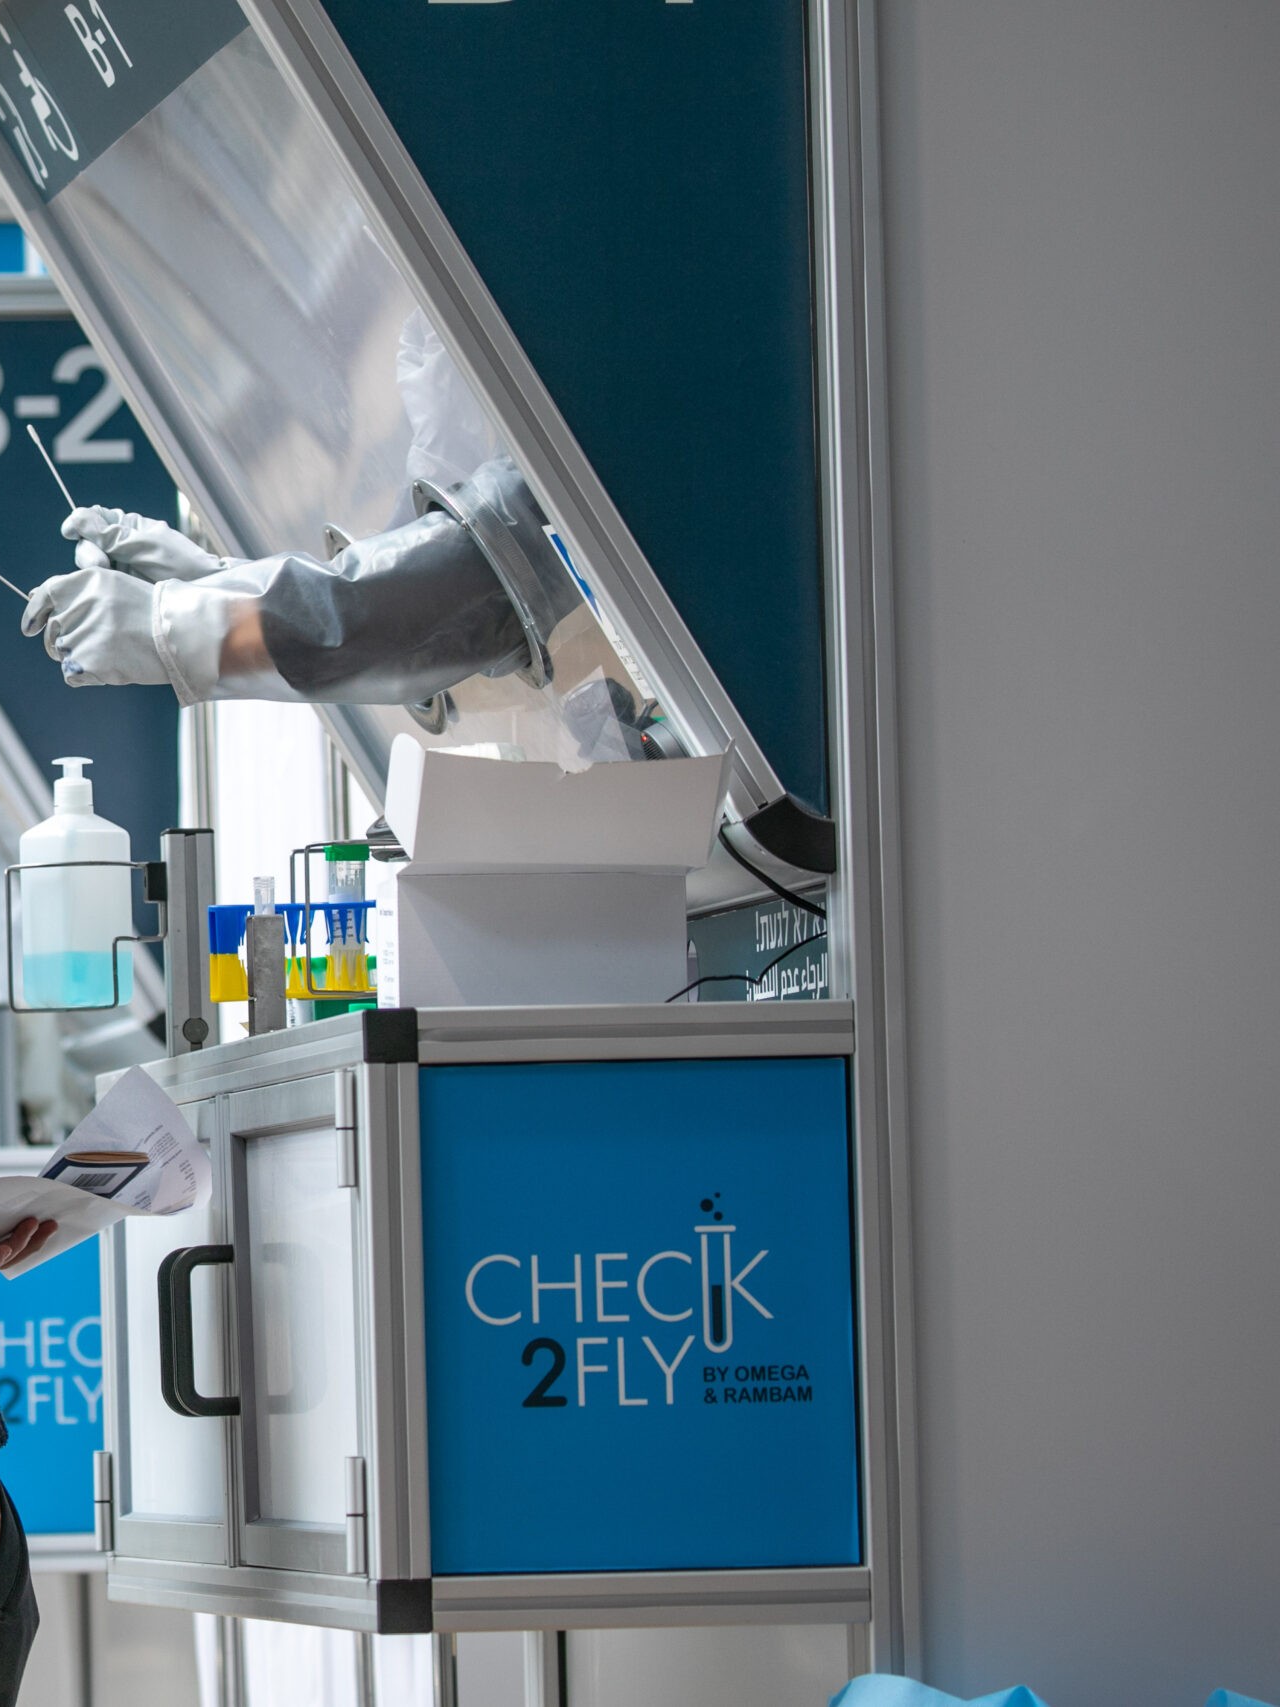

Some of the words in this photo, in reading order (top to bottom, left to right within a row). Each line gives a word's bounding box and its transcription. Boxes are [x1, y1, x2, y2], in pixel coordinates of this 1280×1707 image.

[64, 0, 133, 88] B-1
[756, 900, 789, 952] לגעת!
[780, 967, 800, 1001] عدم
[465, 1236, 775, 1340] CHECK
[522, 1335, 696, 1408] 2FLY
[703, 1366, 729, 1382] BY
[734, 1364, 810, 1382] OMEGA
[703, 1387, 718, 1404] &
[724, 1385, 813, 1403] RAMBAM
